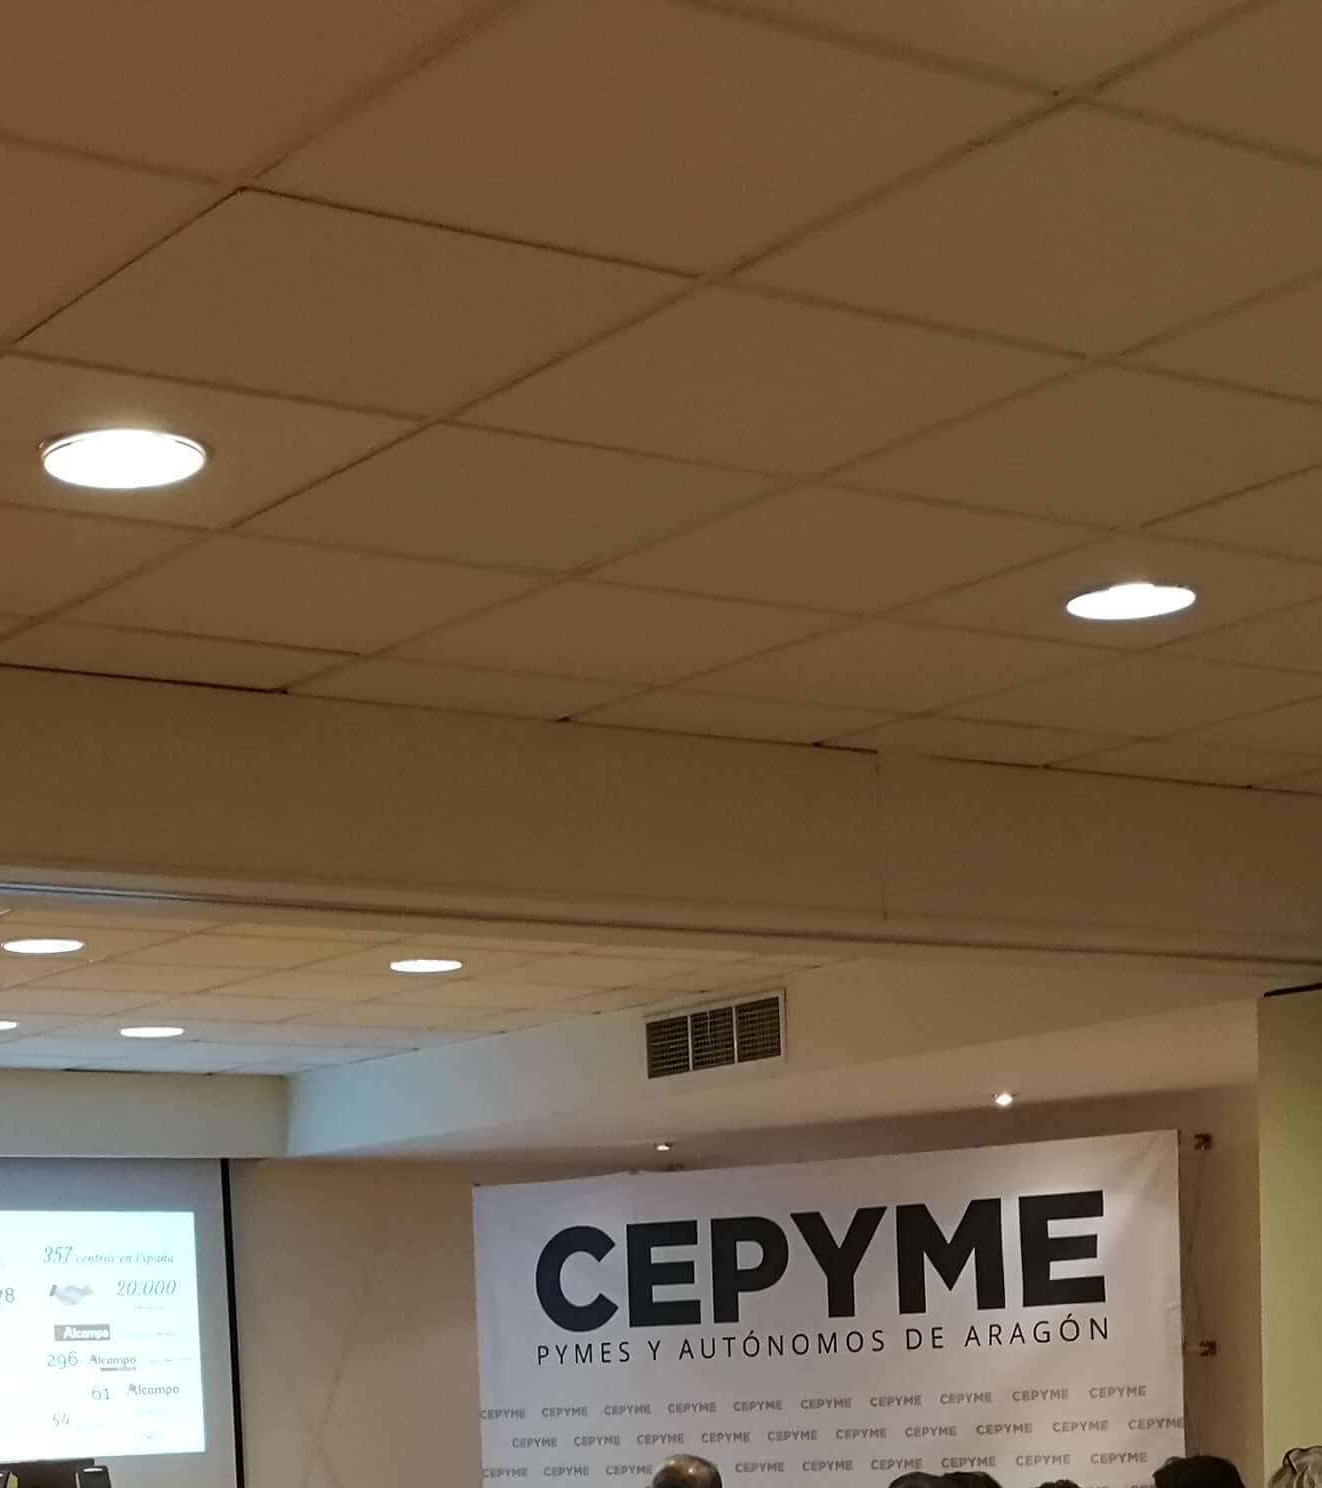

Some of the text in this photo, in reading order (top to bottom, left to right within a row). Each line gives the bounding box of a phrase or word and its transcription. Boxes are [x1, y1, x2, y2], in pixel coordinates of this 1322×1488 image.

[43, 1245, 74, 1264] 357
[535, 1190, 1106, 1332] CEPYME
[537, 1313, 1108, 1366] PYMES Y AUTÓNOMOS DE ARAGÓN
[127, 1383, 180, 1396] Alcampo
[541, 1406, 588, 1417] CEPYME
[604, 1404, 652, 1416] CEPYME
[667, 1402, 717, 1414] CEPYME
[733, 1400, 783, 1412] CEPYME
[800, 1398, 852, 1410] CEPYME
[869, 1395, 922, 1408] CEPYME
[940, 1391, 992, 1405] CEPYME
[1012, 1388, 1070, 1402] CEPYME
[1089, 1385, 1147, 1399] CEPYME
[512, 1437, 558, 1448] CEPYME
[573, 1435, 621, 1447] CEPYME
[636, 1433, 685, 1445] CEPYME
[701, 1431, 750, 1444] CEPYME
[767, 1430, 818, 1442] CEPYME
[835, 1428, 887, 1440] CEPYME
[904, 1426, 957, 1438] CEPYME
[976, 1423, 1033, 1435] CEPYME
[1052, 1420, 1109, 1433] CEPYME
[543, 1466, 589, 1477] CEPYME
[605, 1464, 653, 1476] CEPYME
[735, 1462, 785, 1473] CEPYME
[802, 1460, 853, 1472] CEPYME
[871, 1458, 923, 1471] CEPYME
[941, 1456, 997, 1469] CEPYME
[1016, 1454, 1071, 1467] CEPYME
[1090, 1451, 1148, 1464] CEPYME
